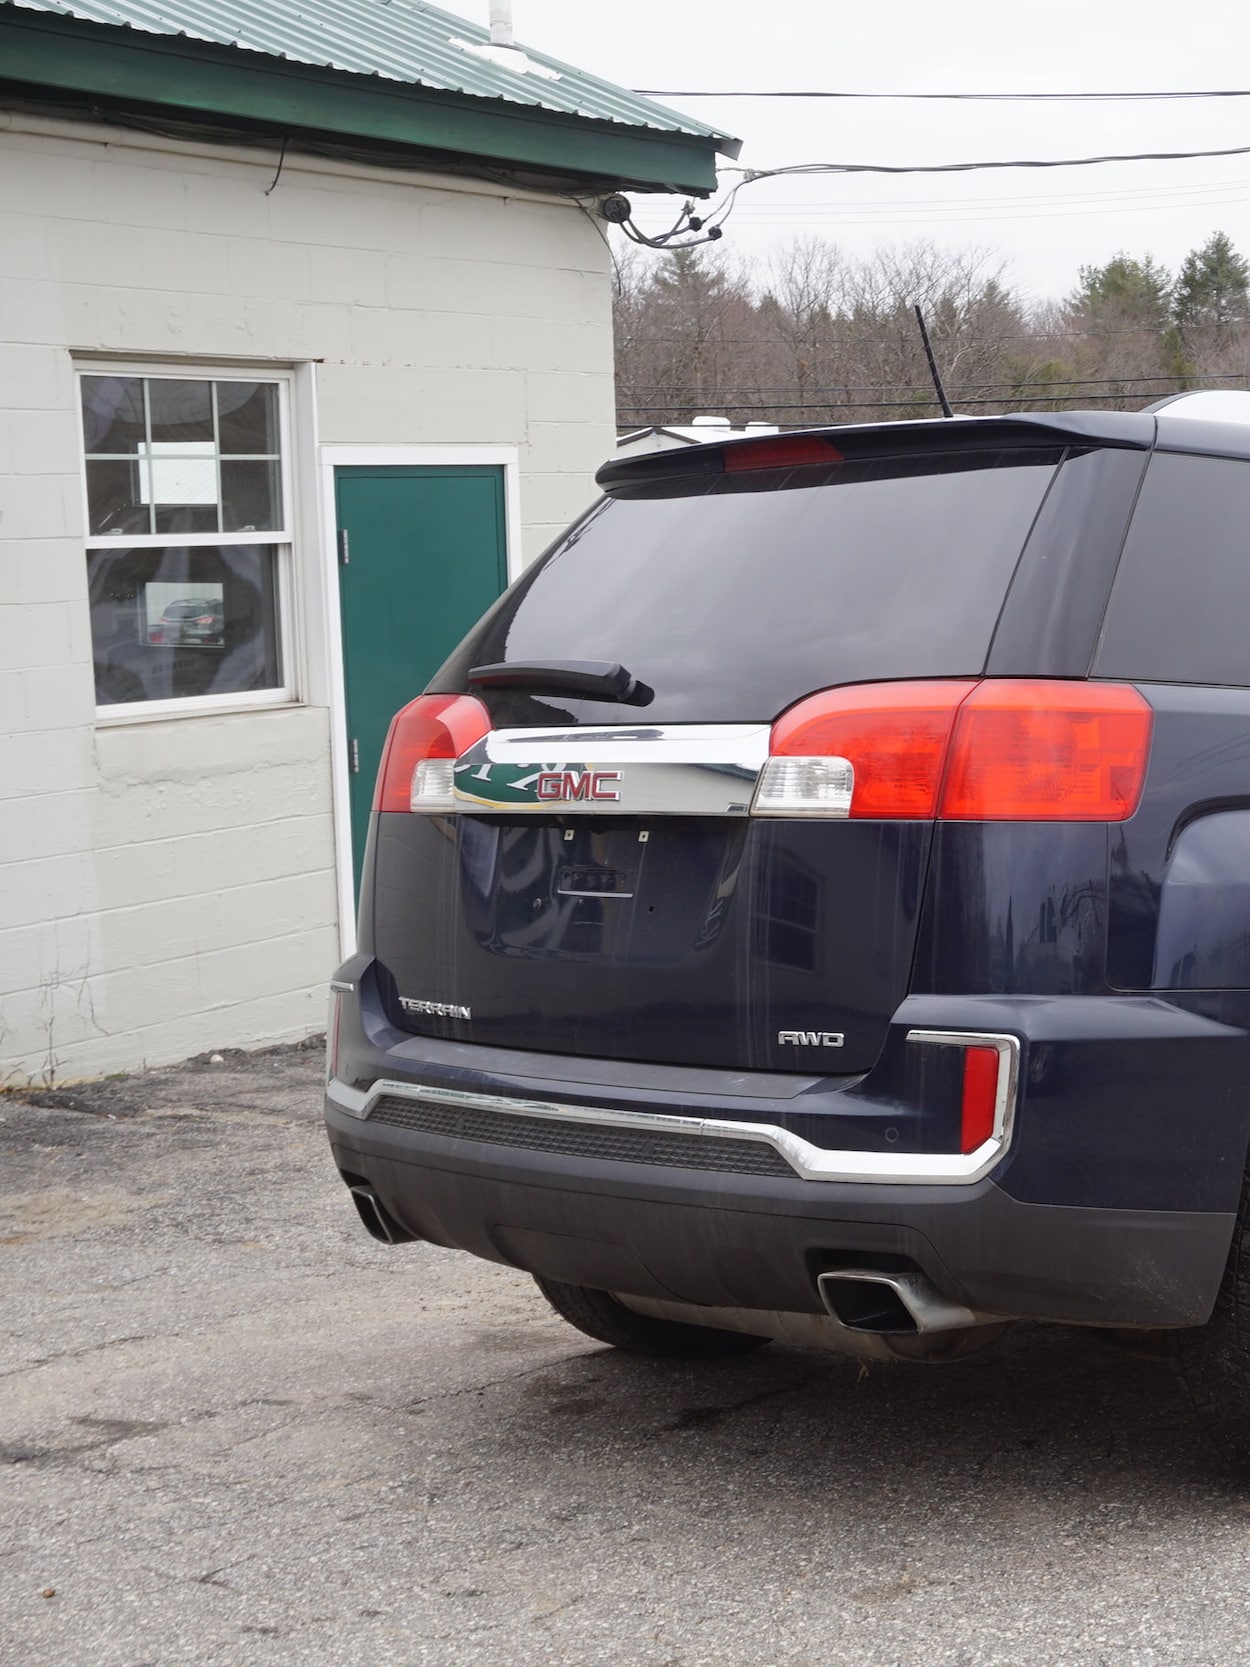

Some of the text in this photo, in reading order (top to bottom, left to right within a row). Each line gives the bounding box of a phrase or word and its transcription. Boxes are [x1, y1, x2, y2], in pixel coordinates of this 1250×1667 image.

[537, 770, 624, 801] GMC
[398, 996, 472, 1020] TERRAIN
[778, 1030, 845, 1047] AWD
